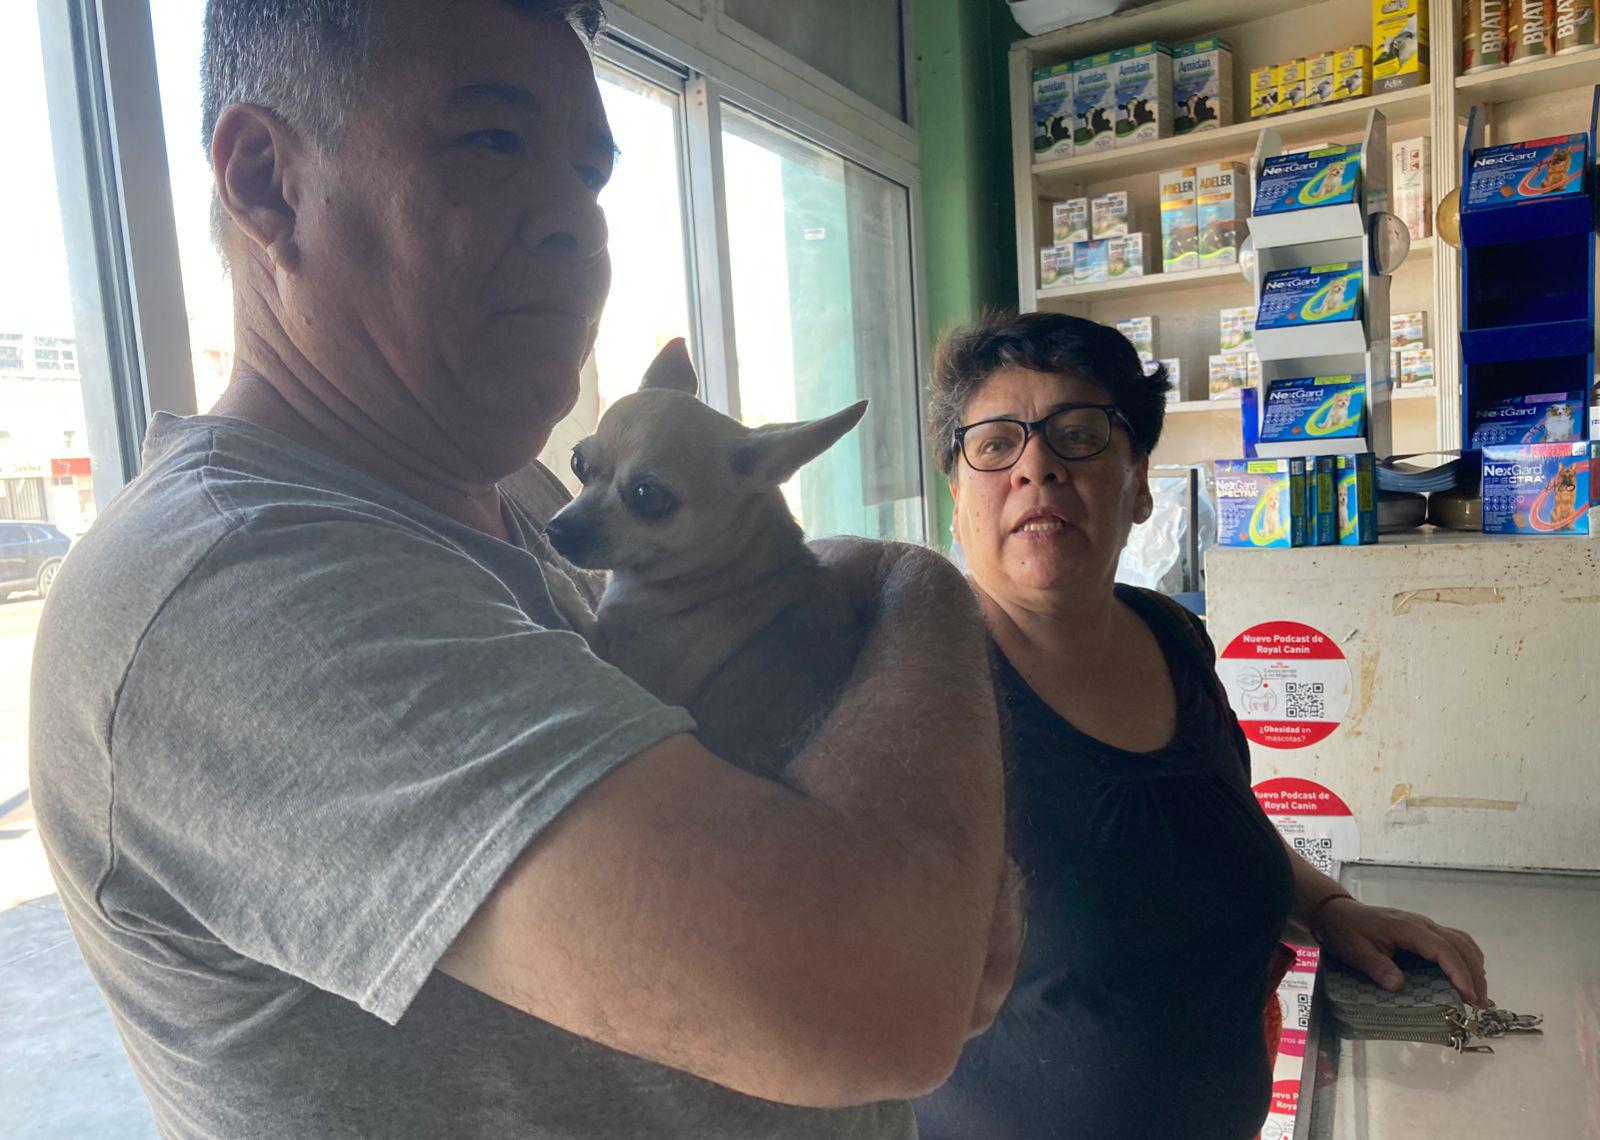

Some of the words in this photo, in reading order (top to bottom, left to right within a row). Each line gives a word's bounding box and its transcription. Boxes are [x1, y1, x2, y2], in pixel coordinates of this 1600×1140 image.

[1557, 0, 1575, 39] BRA
[1119, 61, 1150, 76] Amidan
[1179, 58, 1211, 73] Amidan
[1078, 71, 1107, 86] Amidan
[1037, 80, 1066, 95] Amidan
[1473, 151, 1537, 168] NexGard
[1263, 161, 1318, 177] NexGard
[1162, 180, 1194, 196] ADELER
[1200, 174, 1232, 190] ADELER
[1265, 276, 1321, 291] NexGard
[1270, 388, 1324, 401] NexGard
[1476, 406, 1537, 418] NexGard
[1483, 464, 1543, 477] NexGard
[1216, 479, 1258, 492] NexGard
[1216, 489, 1259, 498] SPECTRA
[1243, 635, 1272, 643] Nuevo
[1273, 634, 1310, 643] Podcast
[1312, 635, 1324, 643] de
[1256, 645, 1281, 655] Royal
[1283, 645, 1310, 654] Canin
[1259, 725, 1300, 734] ¿Obesidad
[1265, 735, 1306, 743] mascotas?
[1281, 790, 1317, 799] Podcast
[1319, 791, 1330, 800] de
[1264, 801, 1289, 811] Royal
[1291, 801, 1317, 810] Canin
[1276, 1100, 1298, 1110] Roya
